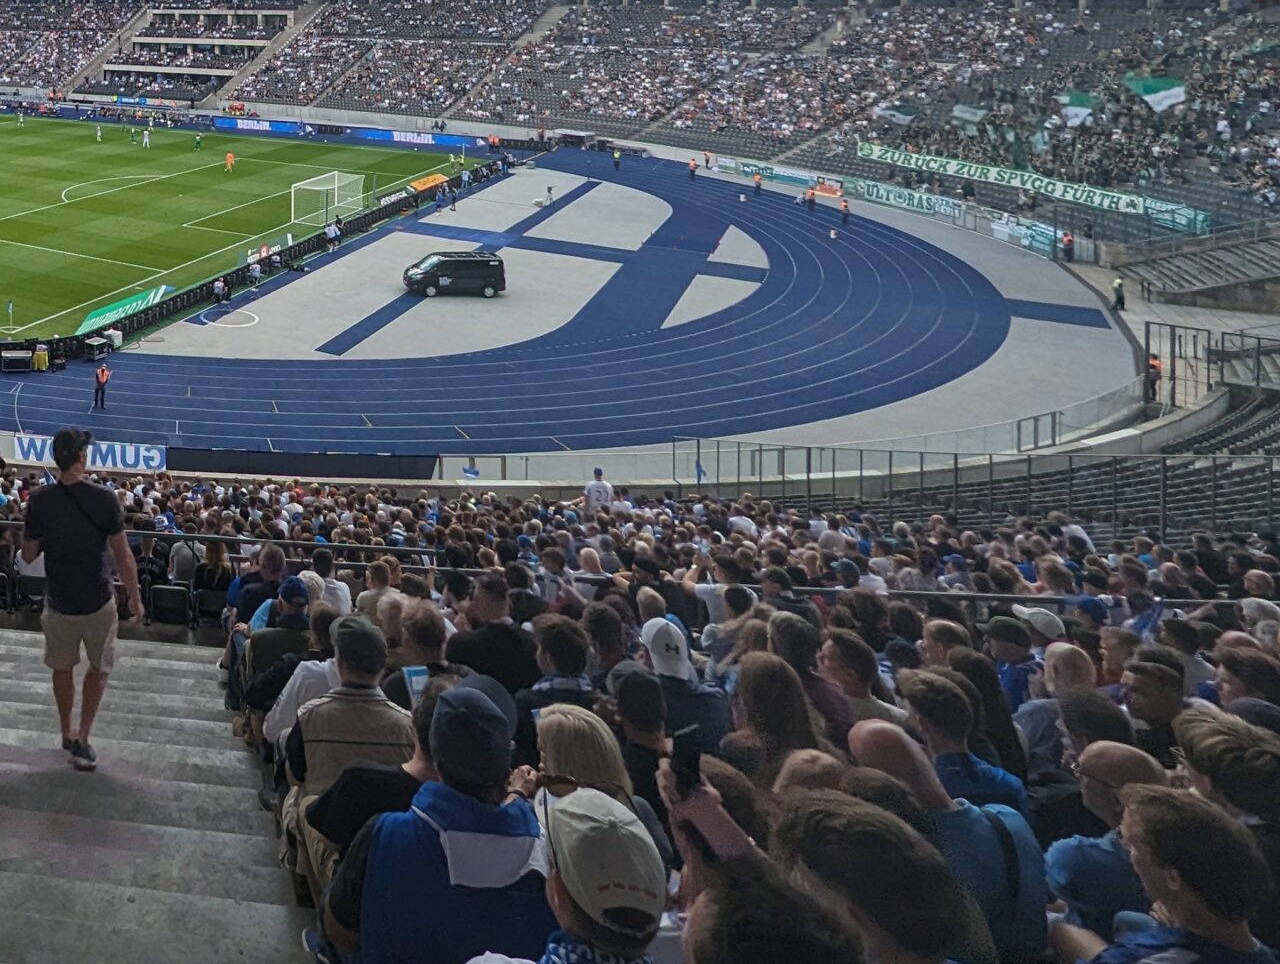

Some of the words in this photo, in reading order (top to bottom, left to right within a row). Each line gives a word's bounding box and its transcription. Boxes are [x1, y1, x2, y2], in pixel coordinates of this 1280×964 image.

[877, 147, 951, 173] ZURÜCK
[952, 162, 990, 180] ZUR
[994, 169, 1056, 195] SPVGG
[1061, 183, 1123, 210] FÜRTH
